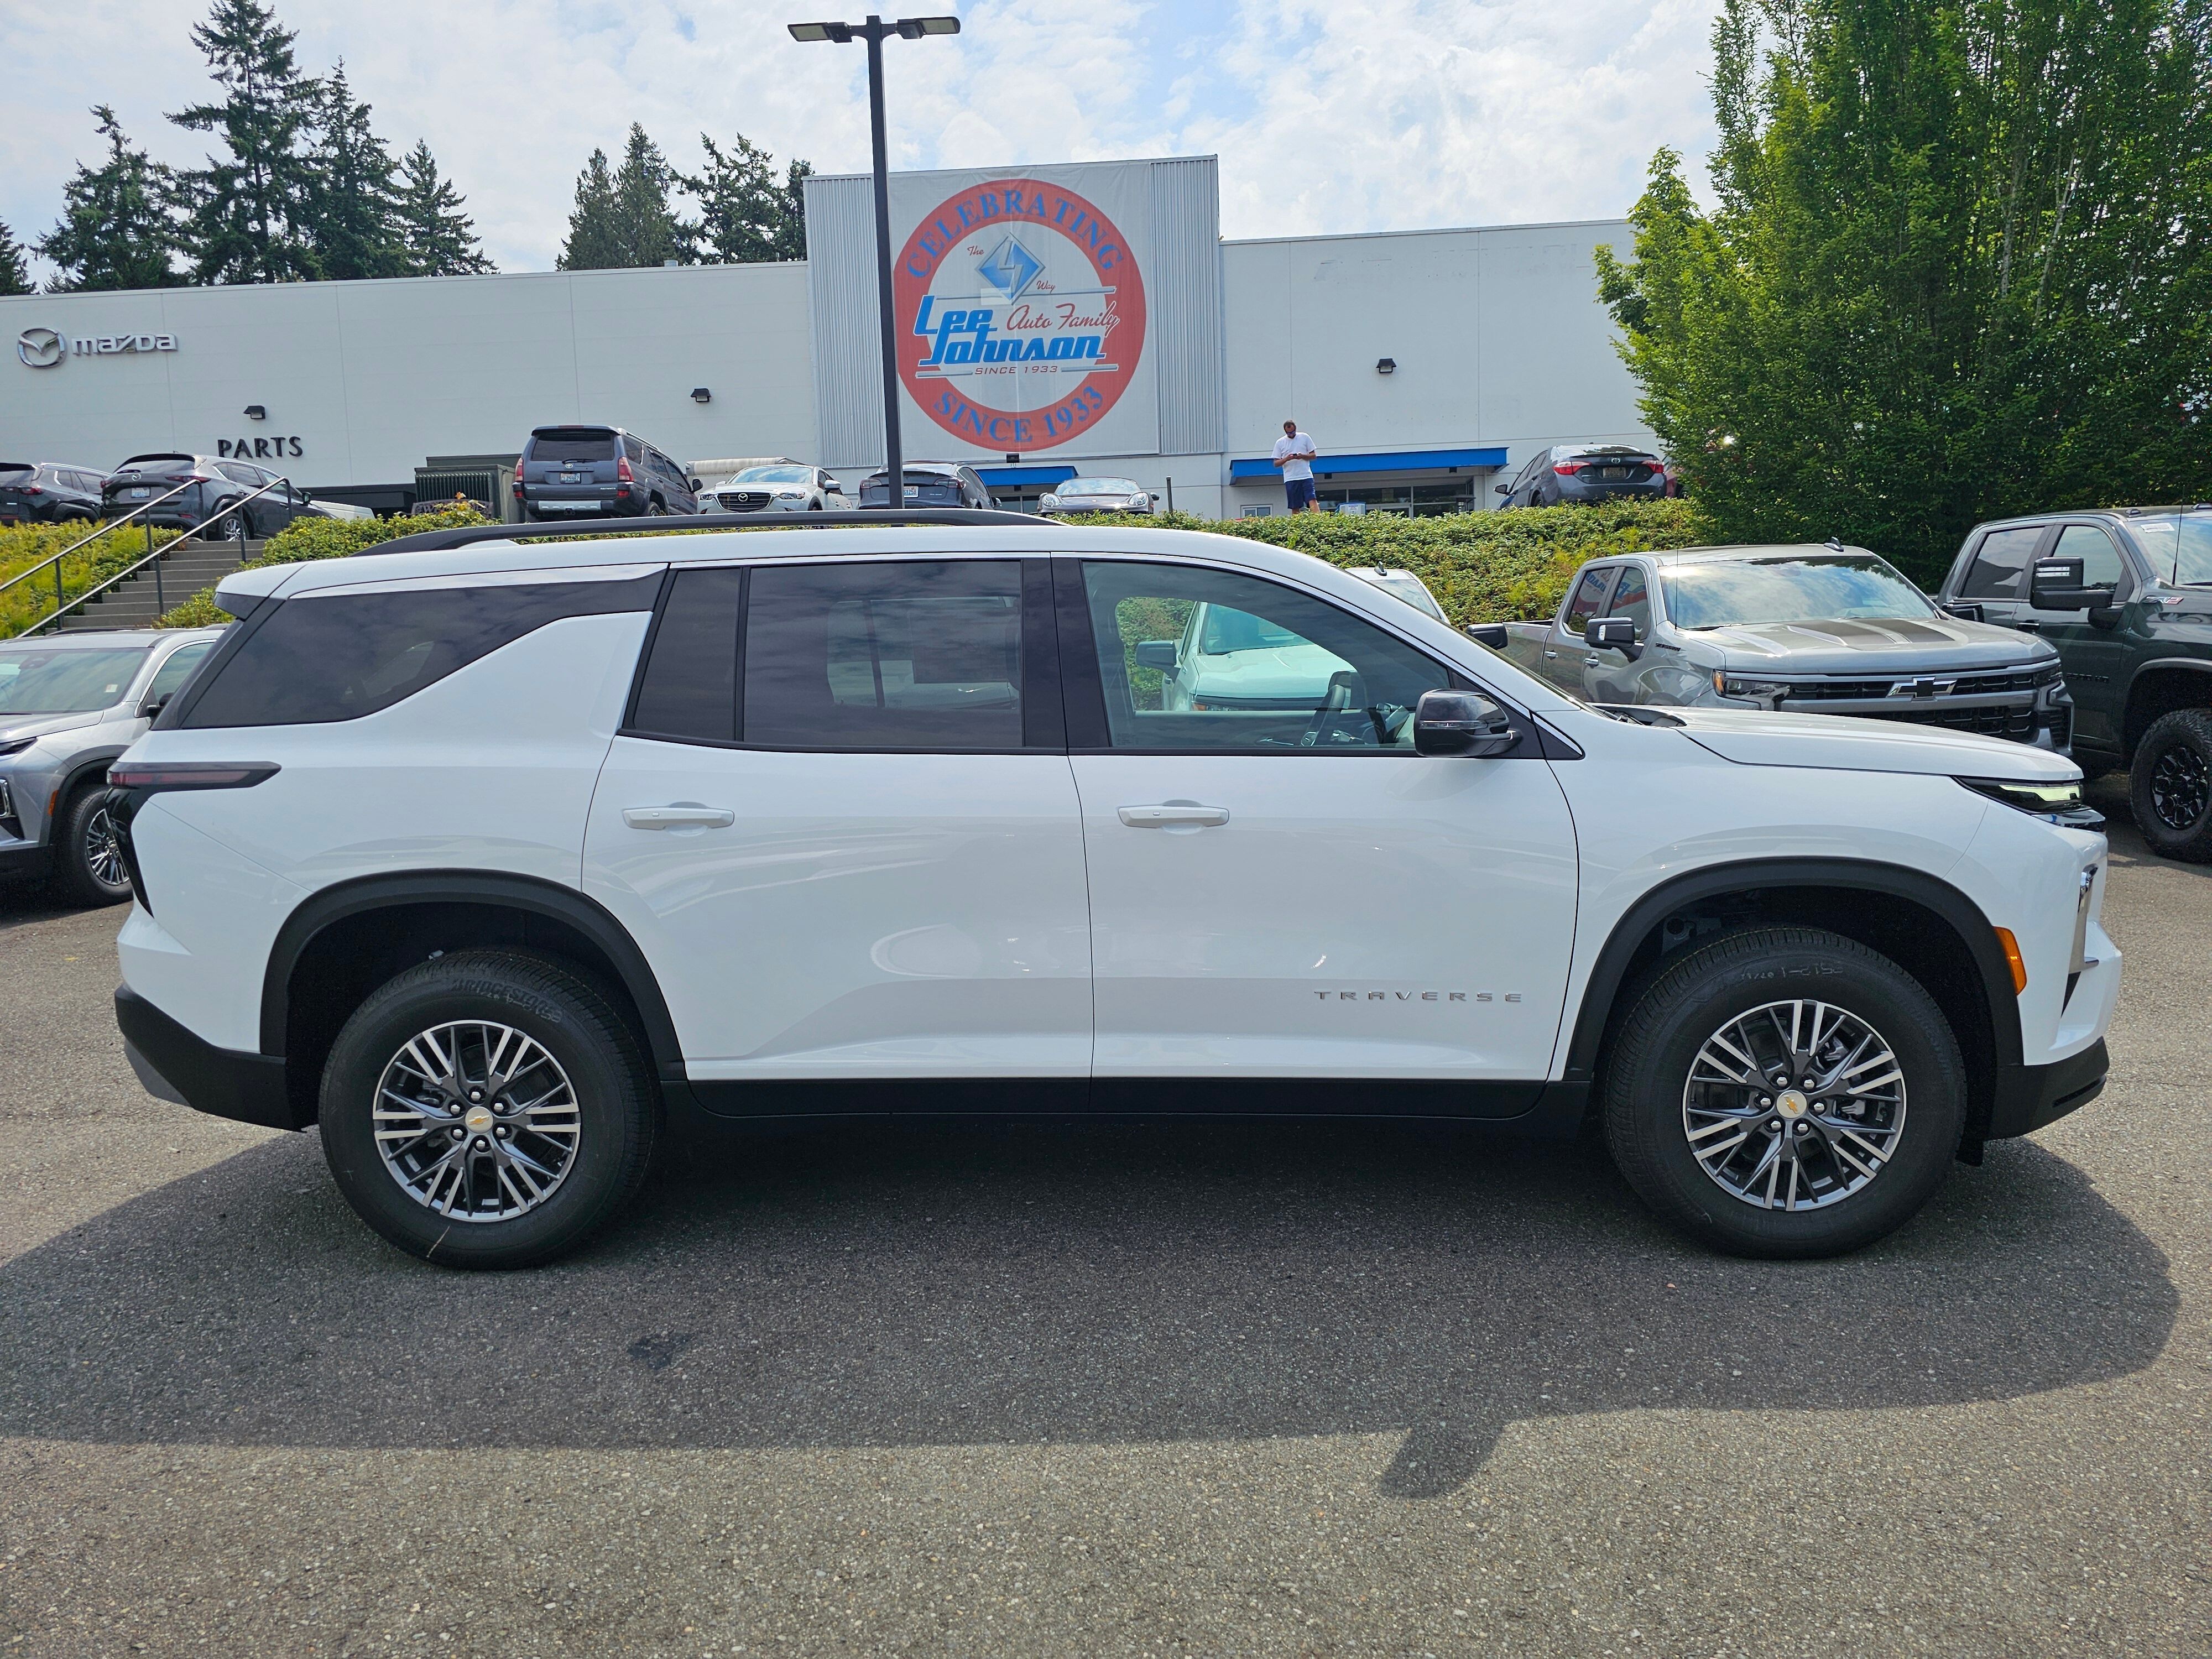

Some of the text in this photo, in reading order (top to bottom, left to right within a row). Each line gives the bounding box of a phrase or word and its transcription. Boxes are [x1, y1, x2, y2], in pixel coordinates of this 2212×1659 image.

[906, 190, 1124, 278] CELEBRATING
[967, 245, 984, 256] The
[1036, 280, 1055, 294] Way
[914, 295, 998, 335] Lee
[1006, 301, 1120, 338] Auto Family
[918, 330, 1107, 367] Johnson
[974, 366, 1058, 375] SINCE 1933
[933, 385, 1104, 443] SINCE 1933
[217, 436, 304, 459] PARTS
[1314, 990, 1522, 1002] TRAVERSE
